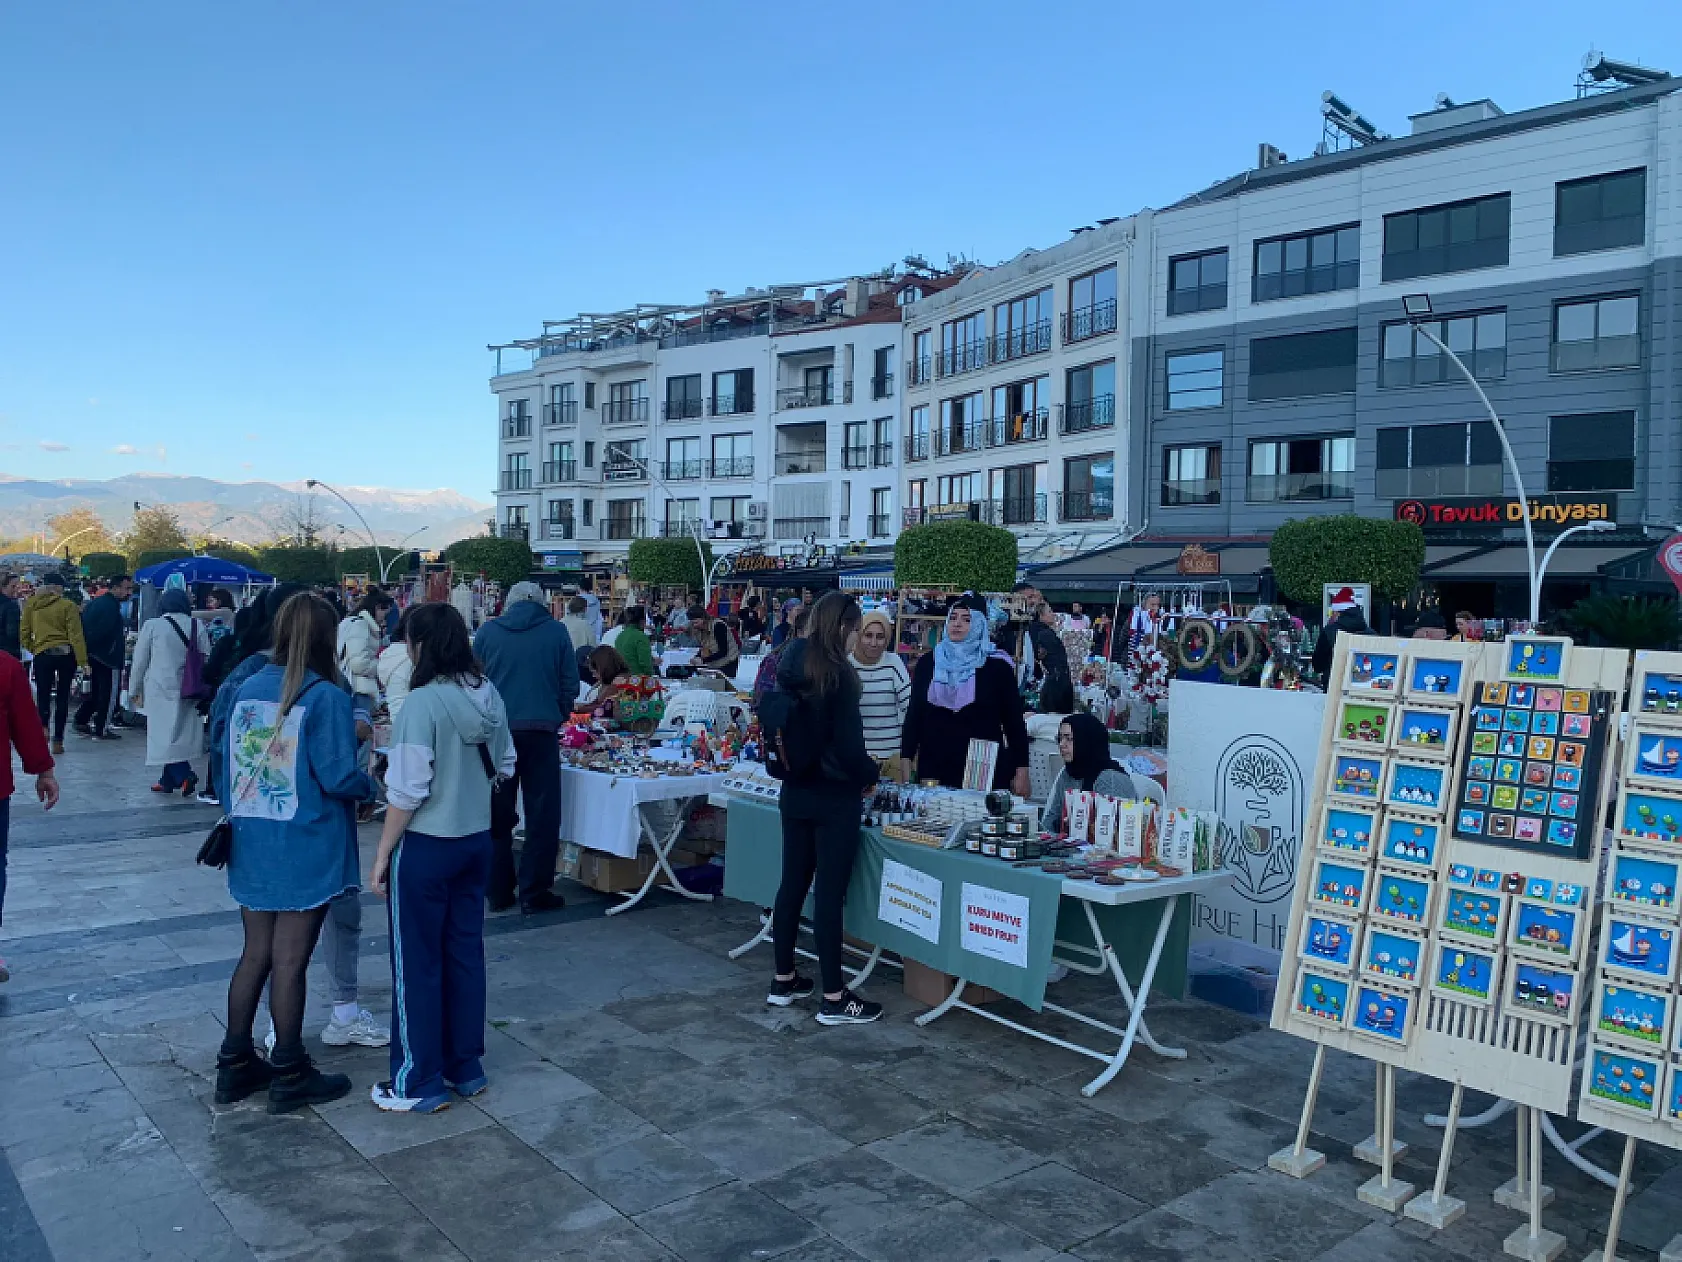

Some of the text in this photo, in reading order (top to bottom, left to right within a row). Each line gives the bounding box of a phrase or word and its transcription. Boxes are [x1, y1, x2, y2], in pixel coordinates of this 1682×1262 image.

[1430, 500, 1607, 523] Tavuk Dünyası
[968, 904, 990, 918] KURU
[1191, 893, 1242, 938] TRUE
[969, 922, 1019, 944] DRIED FRUIT
